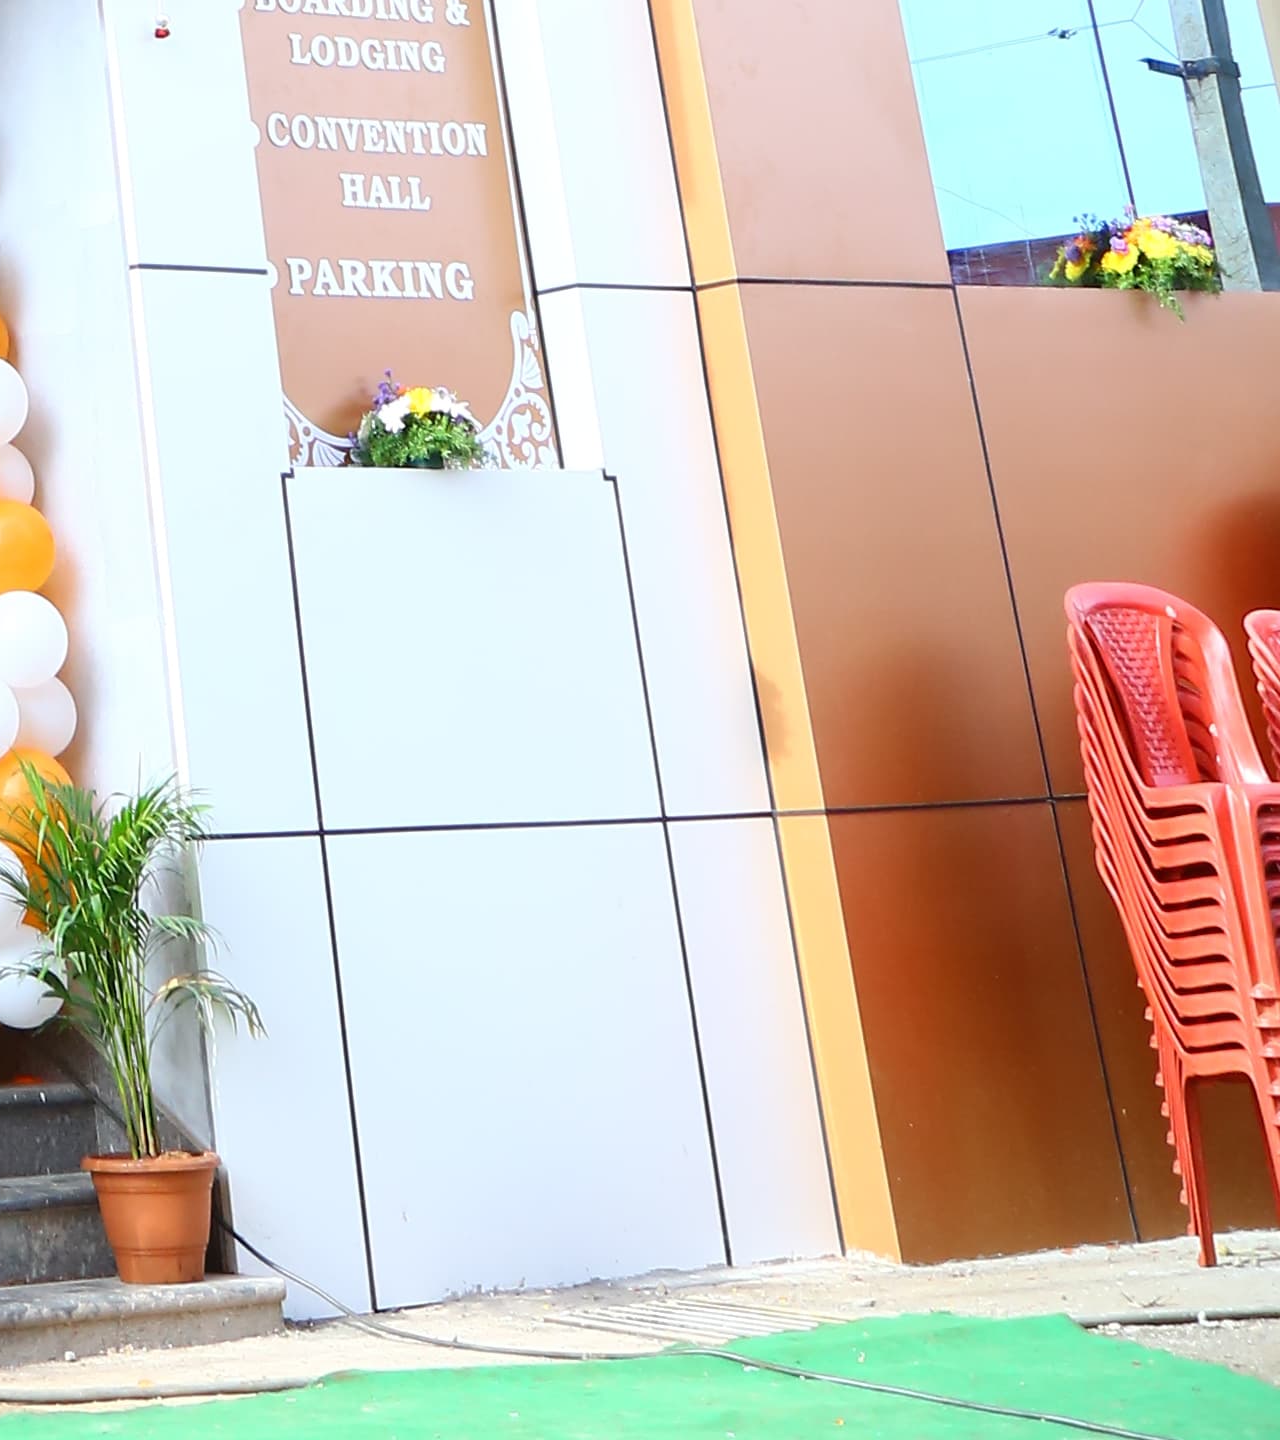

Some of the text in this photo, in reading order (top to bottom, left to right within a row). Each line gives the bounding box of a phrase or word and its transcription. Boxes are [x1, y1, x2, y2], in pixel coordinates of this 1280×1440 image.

[288, 33, 446, 72] LODGING
[267, 112, 487, 156] CONVENTION
[340, 173, 431, 211] HALL
[286, 257, 475, 300] PARKING
